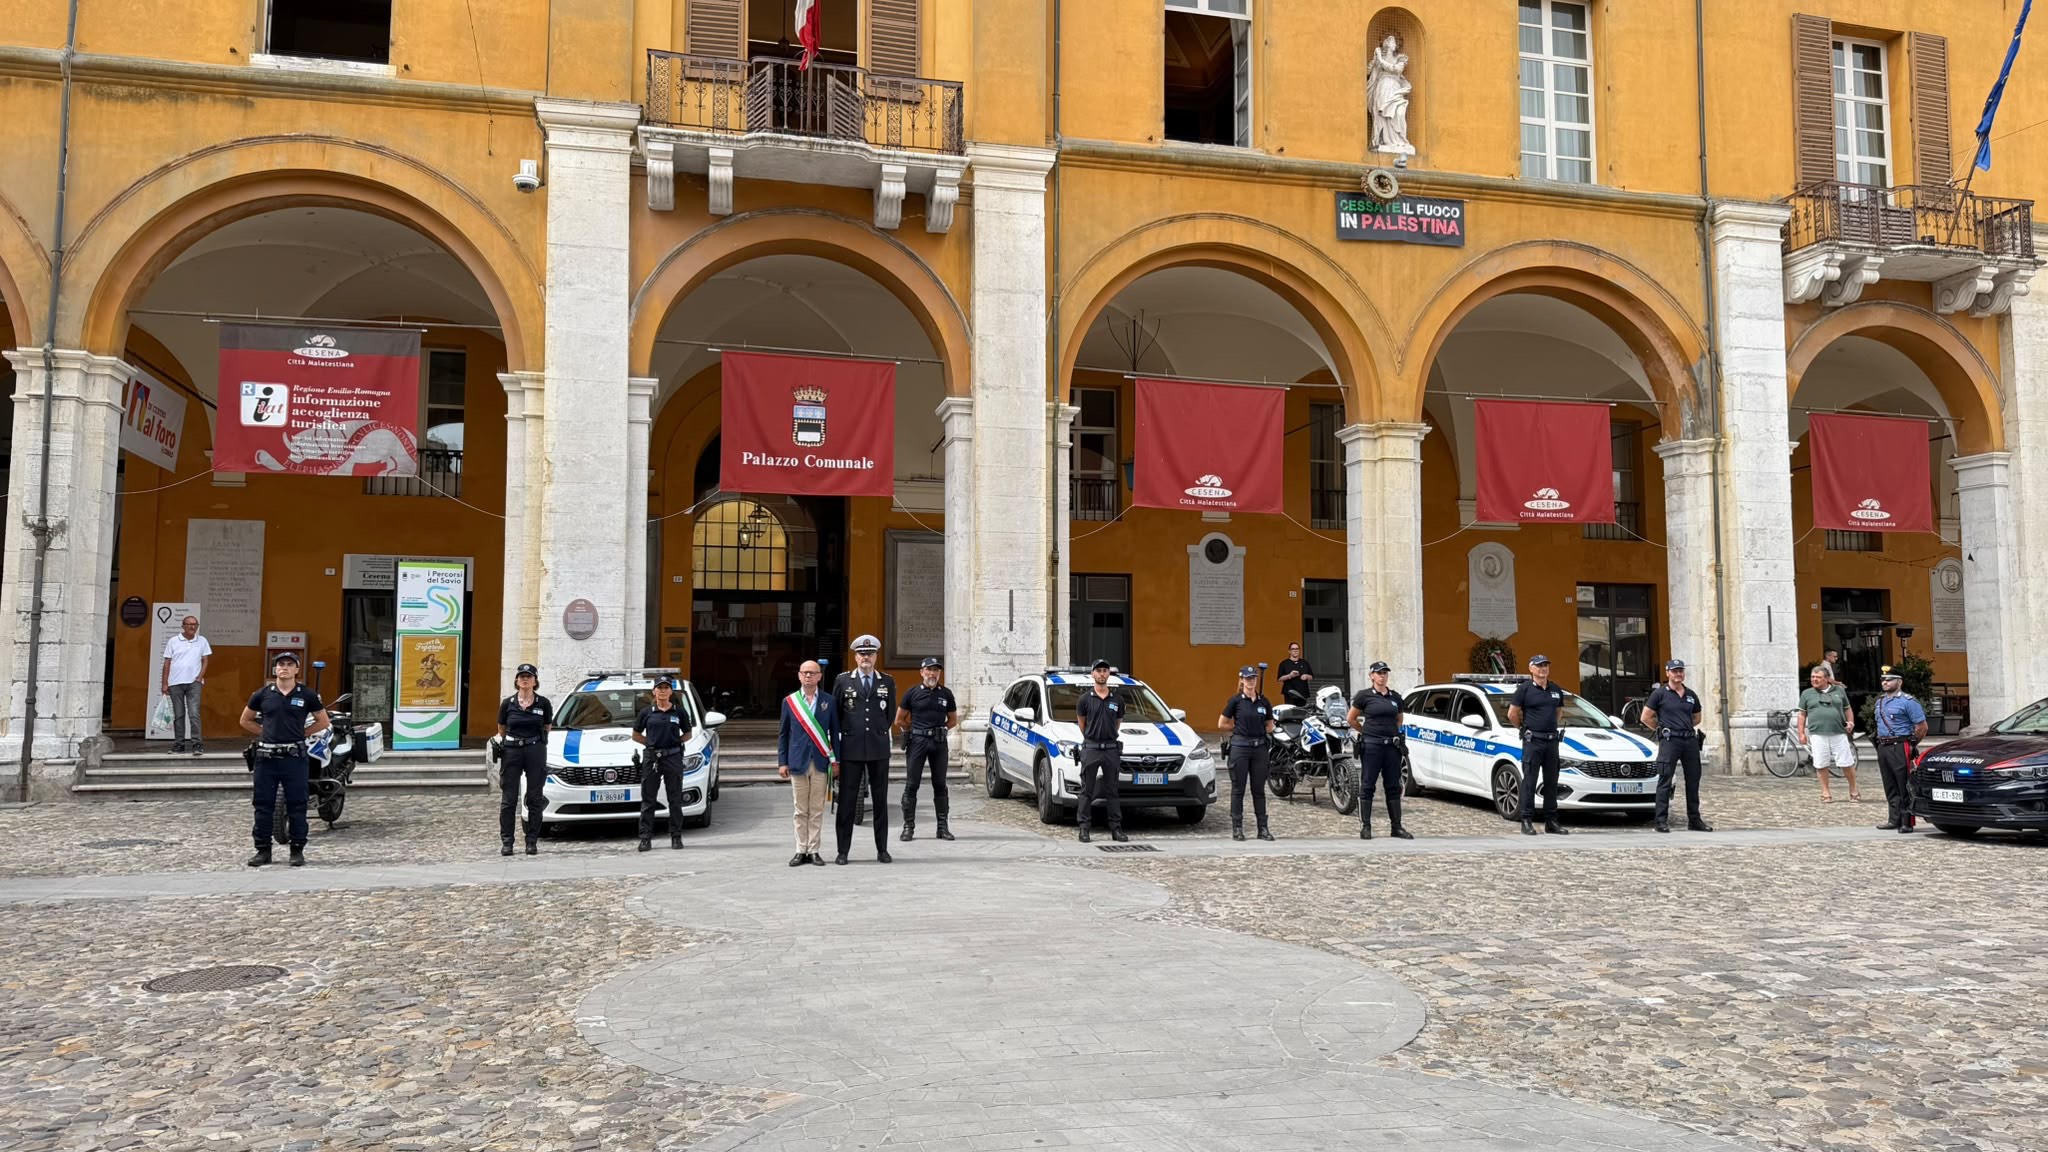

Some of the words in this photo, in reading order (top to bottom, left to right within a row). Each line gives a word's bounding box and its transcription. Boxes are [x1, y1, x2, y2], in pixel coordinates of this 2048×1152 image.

[1402, 203, 1414, 215] IL
[1417, 204, 1460, 218] FUOCO
[1340, 212, 1358, 229] IN
[1361, 214, 1460, 236] PALESTINA
[301, 348, 342, 357] CESENA
[287, 358, 306, 366] Città
[308, 359, 355, 368] Malatestiana
[242, 383, 254, 395] R
[293, 384, 326, 394] Regione
[327, 386, 392, 397] Emilia-Romagna
[292, 394, 382, 409] informazione
[291, 407, 371, 422] accoglienza
[291, 419, 348, 431] turistica
[142, 415, 156, 438] al
[154, 419, 177, 449] foro
[742, 451, 799, 467] Palazzo
[804, 454, 875, 470] Comunale
[1191, 488, 1226, 497] CESENA
[1197, 499, 1237, 507] Malatestiana
[1530, 501, 1564, 509] CESENA
[432, 570, 463, 578] Percorsi
[440, 577, 462, 585] Savio
[1417, 728, 1438, 742] Polizia
[1454, 736, 1476, 750] Locale
[1927, 756, 1985, 765] CARABINIERI
